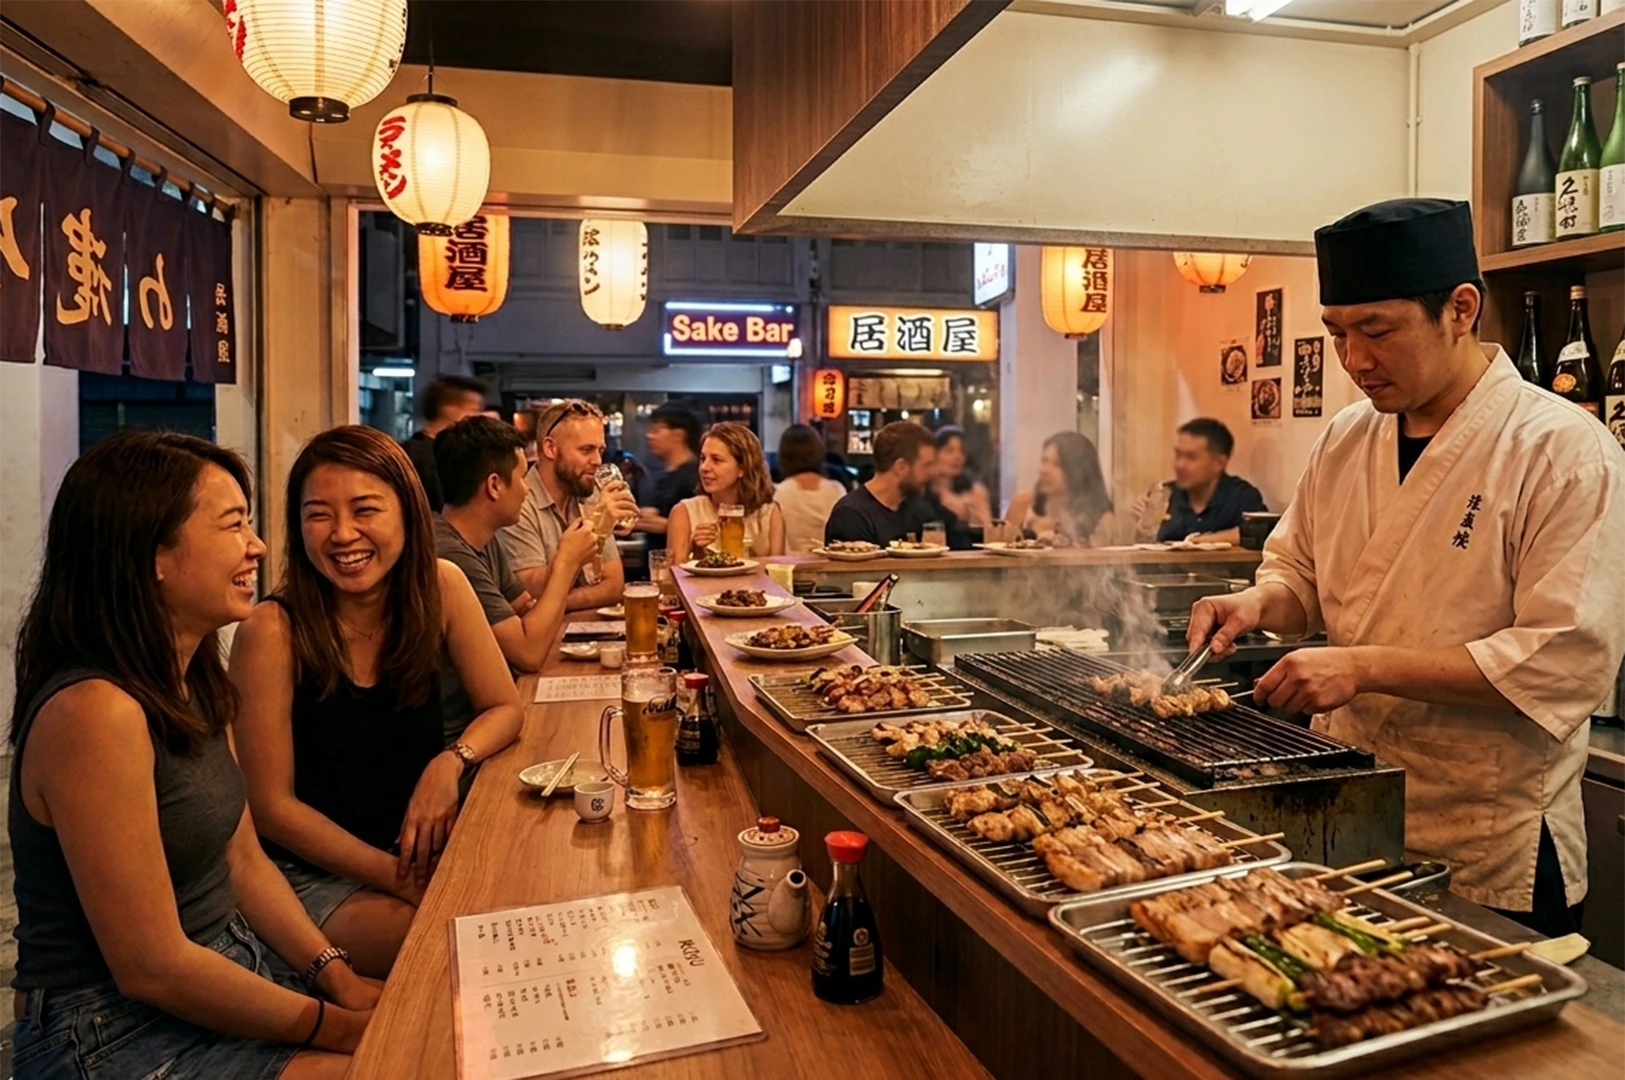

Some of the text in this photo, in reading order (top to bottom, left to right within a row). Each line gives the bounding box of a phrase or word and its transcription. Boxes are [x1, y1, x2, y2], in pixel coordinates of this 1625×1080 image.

[1081, 248, 1108, 313] 居酒屋
[672, 314, 795, 343] Sake Bar
[850, 314, 977, 353] 居酒屋
